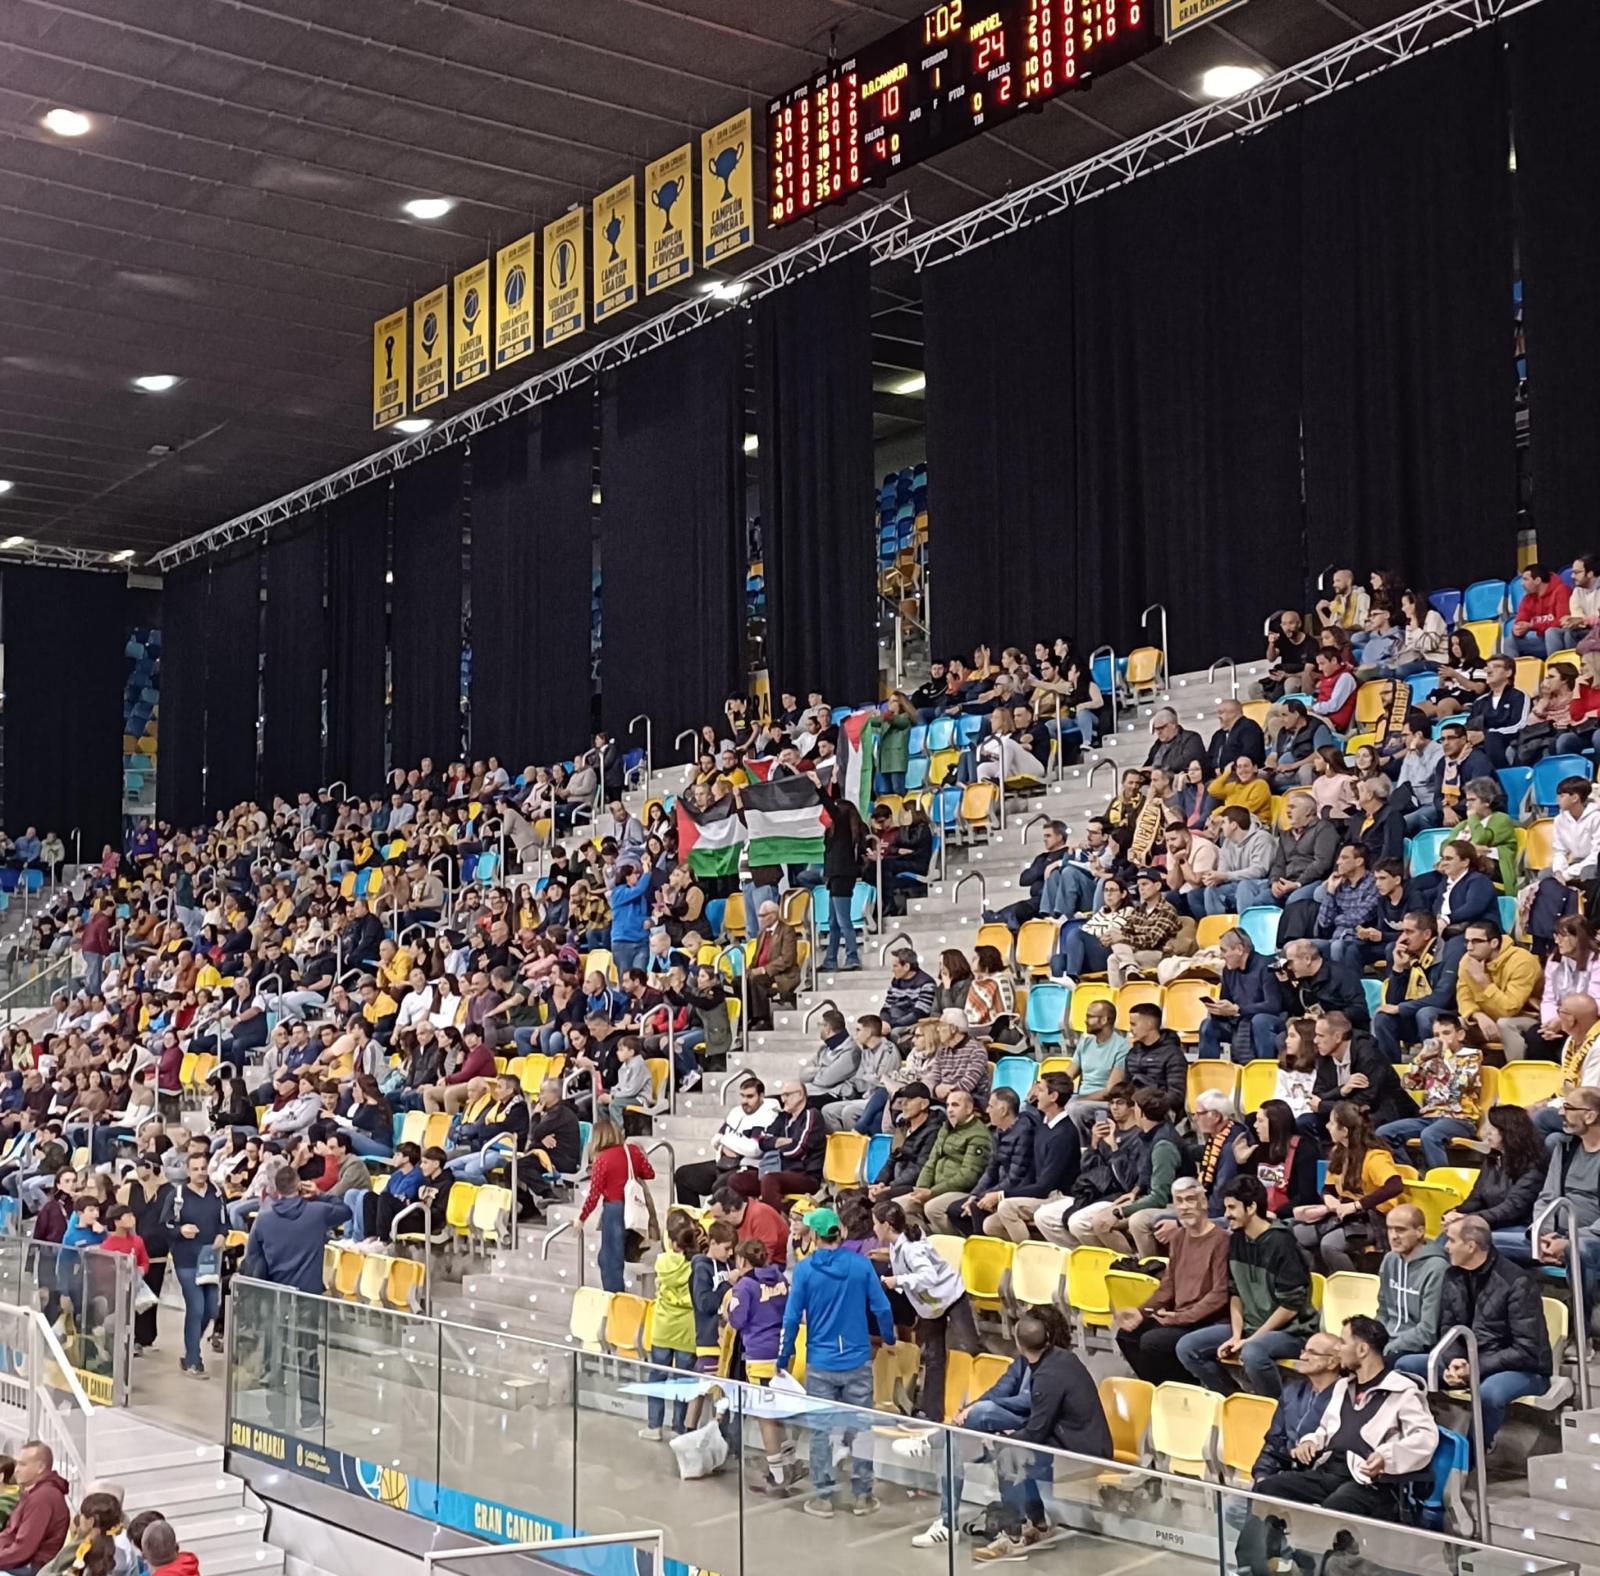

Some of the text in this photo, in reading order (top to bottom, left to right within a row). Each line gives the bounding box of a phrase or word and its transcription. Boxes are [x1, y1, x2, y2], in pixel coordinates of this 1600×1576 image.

[926, 0, 962, 44] 1:02
[1028, 15, 1037, 34] 2
[1042, 8, 1050, 26] 0
[1107, 17, 1115, 36] 0
[1131, 5, 1139, 24] 0
[1180, 3, 1198, 20] GRAN
[970, 13, 1002, 41] HAPOEL
[1029, 17, 1073, 52] 9 0 0
[922, 49, 948, 70] PERIODO
[978, 31, 1004, 68] 24
[1026, 38, 1073, 76] 10 0 0
[842, 59, 855, 73] PTOS
[936, 68, 940, 88] 1
[988, 62, 1010, 81] FALTAS
[1026, 59, 1074, 97] 14 0 0
[794, 86, 807, 100] PTOS
[818, 74, 856, 106] 12 0 4
[883, 86, 898, 117] 10
[974, 93, 981, 111] 0
[1001, 76, 1010, 100] 2
[785, 109, 791, 124] 0
[802, 100, 808, 115] 0
[818, 92, 856, 124] 13 0 2
[909, 85, 965, 122] JUG F PTOS
[776, 118, 808, 148] 3 0 0
[818, 110, 856, 142] 16 0 0
[974, 113, 983, 126] TM
[850, 129, 857, 145] 2
[865, 126, 884, 144] FALTAS
[876, 134, 899, 158] 4 0
[776, 150, 782, 163] 4
[802, 136, 808, 151] 2
[776, 154, 809, 183] 5 0 0
[817, 162, 829, 181] 32
[851, 148, 857, 163] 0
[776, 185, 783, 198] 9
[802, 172, 809, 187] 0
[817, 166, 858, 199] 35 0 0
[773, 190, 809, 220] 10 0 0
[710, 216, 738, 240] PRIMERA
[602, 278, 614, 296] LIGA
[232, 1422, 285, 1460] GRAN CANARIA
[475, 1502, 552, 1544] GRAN CANARIA
